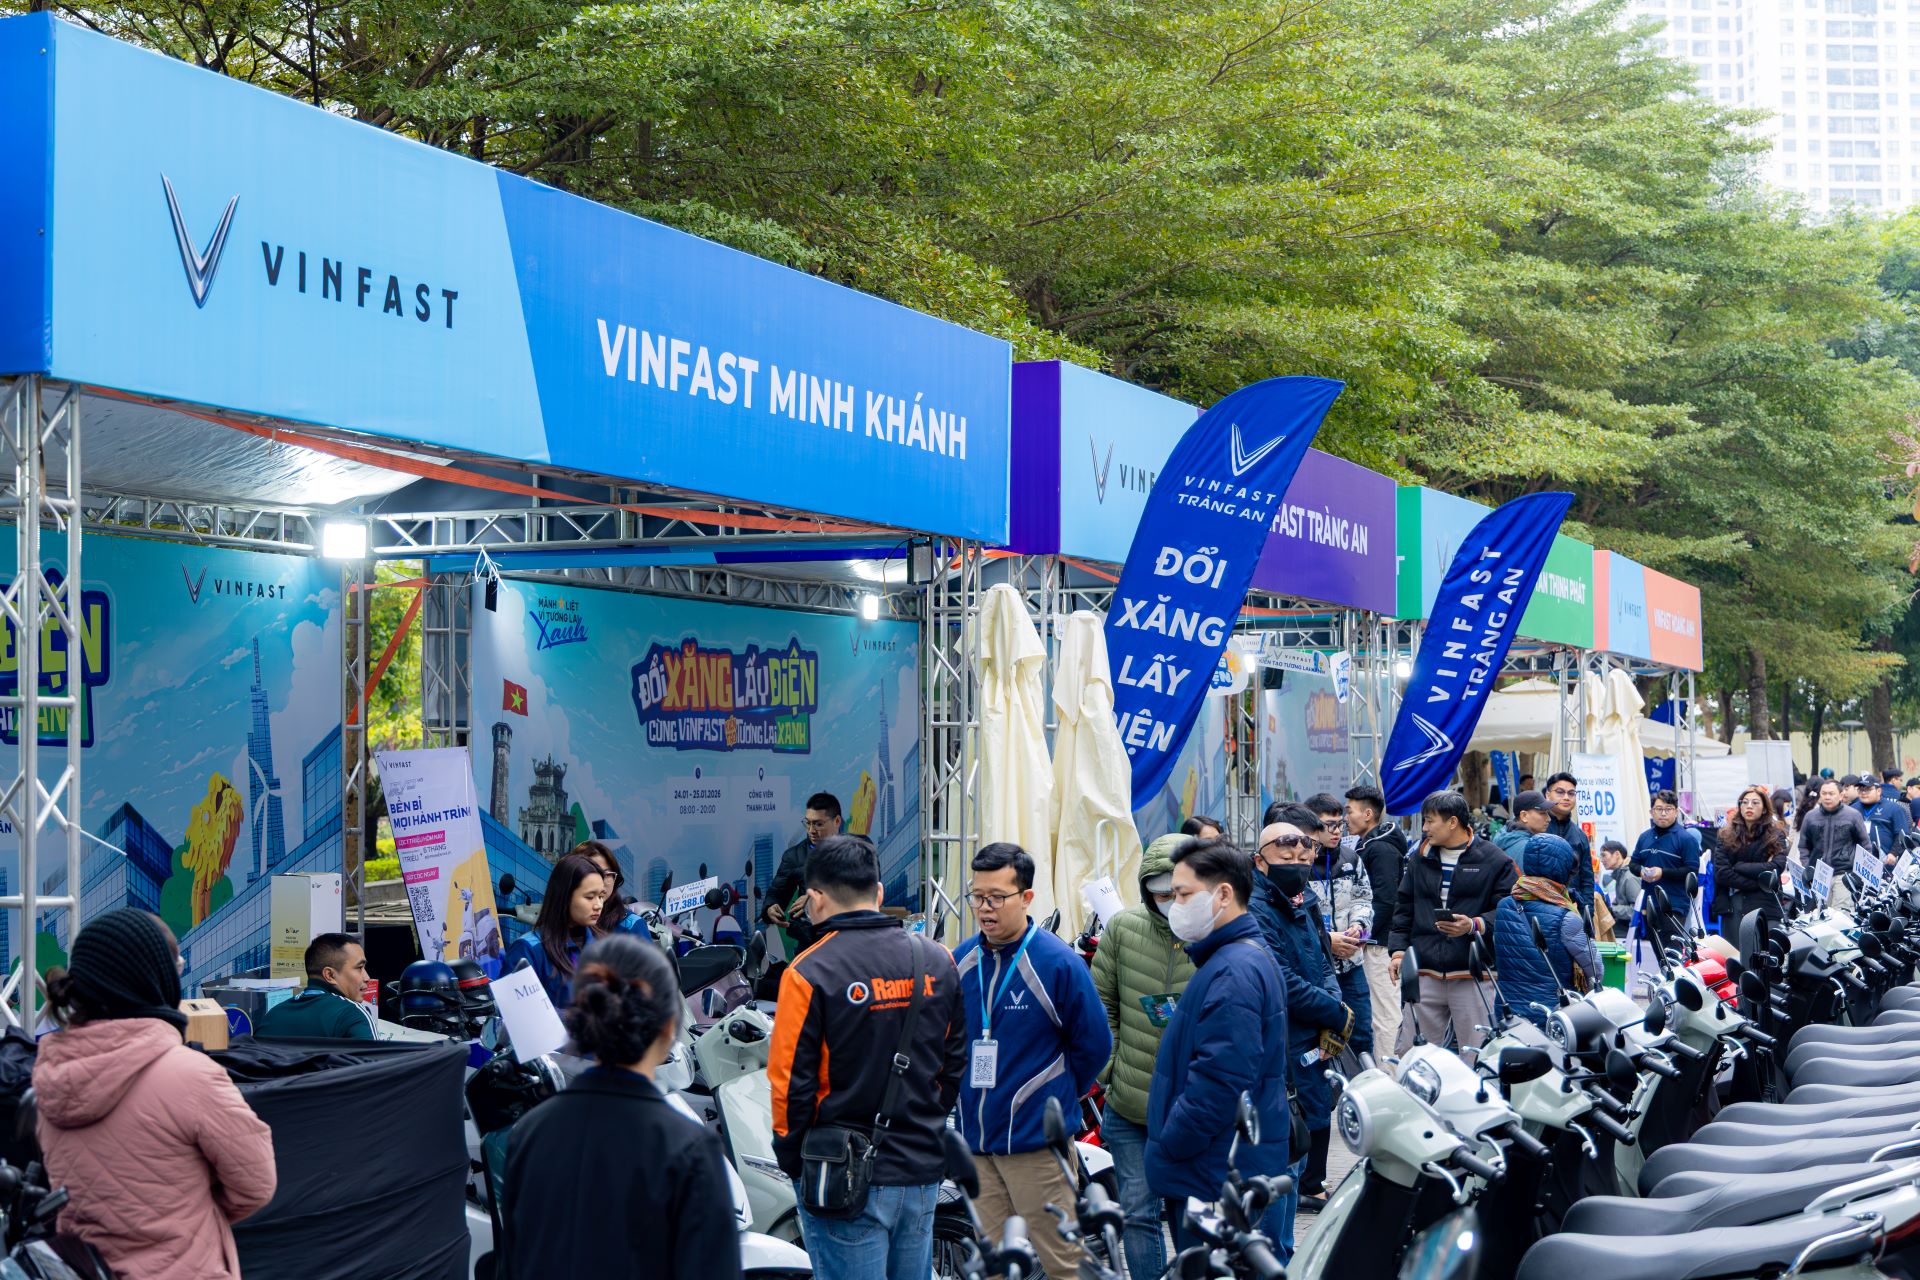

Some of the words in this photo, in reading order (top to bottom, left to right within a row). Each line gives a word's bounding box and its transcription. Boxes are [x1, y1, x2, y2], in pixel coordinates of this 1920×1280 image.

[261, 242, 459, 329] VINFAST
[597, 319, 759, 409] VINFAST
[770, 365, 855, 433] MINH
[865, 392, 967, 460] KHÁNH
[1178, 493, 1236, 515] TRÀNG
[1239, 508, 1266, 523] AN
[1185, 475, 1276, 505] VINFAST
[1307, 506, 1349, 551] TRÀNG
[1351, 523, 1368, 556] AN
[1154, 546, 1227, 589] ĐỔI
[215, 579, 285, 600] VINFAST
[529, 611, 590, 651] Xanh
[1114, 594, 1226, 647] XĂNG
[1428, 546, 1502, 703] VINFAST
[1461, 611, 1508, 701] TRÀNG
[1497, 568, 1525, 605] AN
[864, 640, 896, 651] VINFAST
[662, 645, 734, 709] XĂNG
[734, 653, 769, 709] LẤY
[1118, 654, 1192, 697] LẤY
[776, 721, 806, 745] XANH
[1112, 708, 1177, 755] IỆN
[388, 761, 412, 769] VINFAST
[680, 805, 695, 814] 08:00
[700, 804, 716, 814] 20:00
[669, 894, 705, 912] 17.388.0
